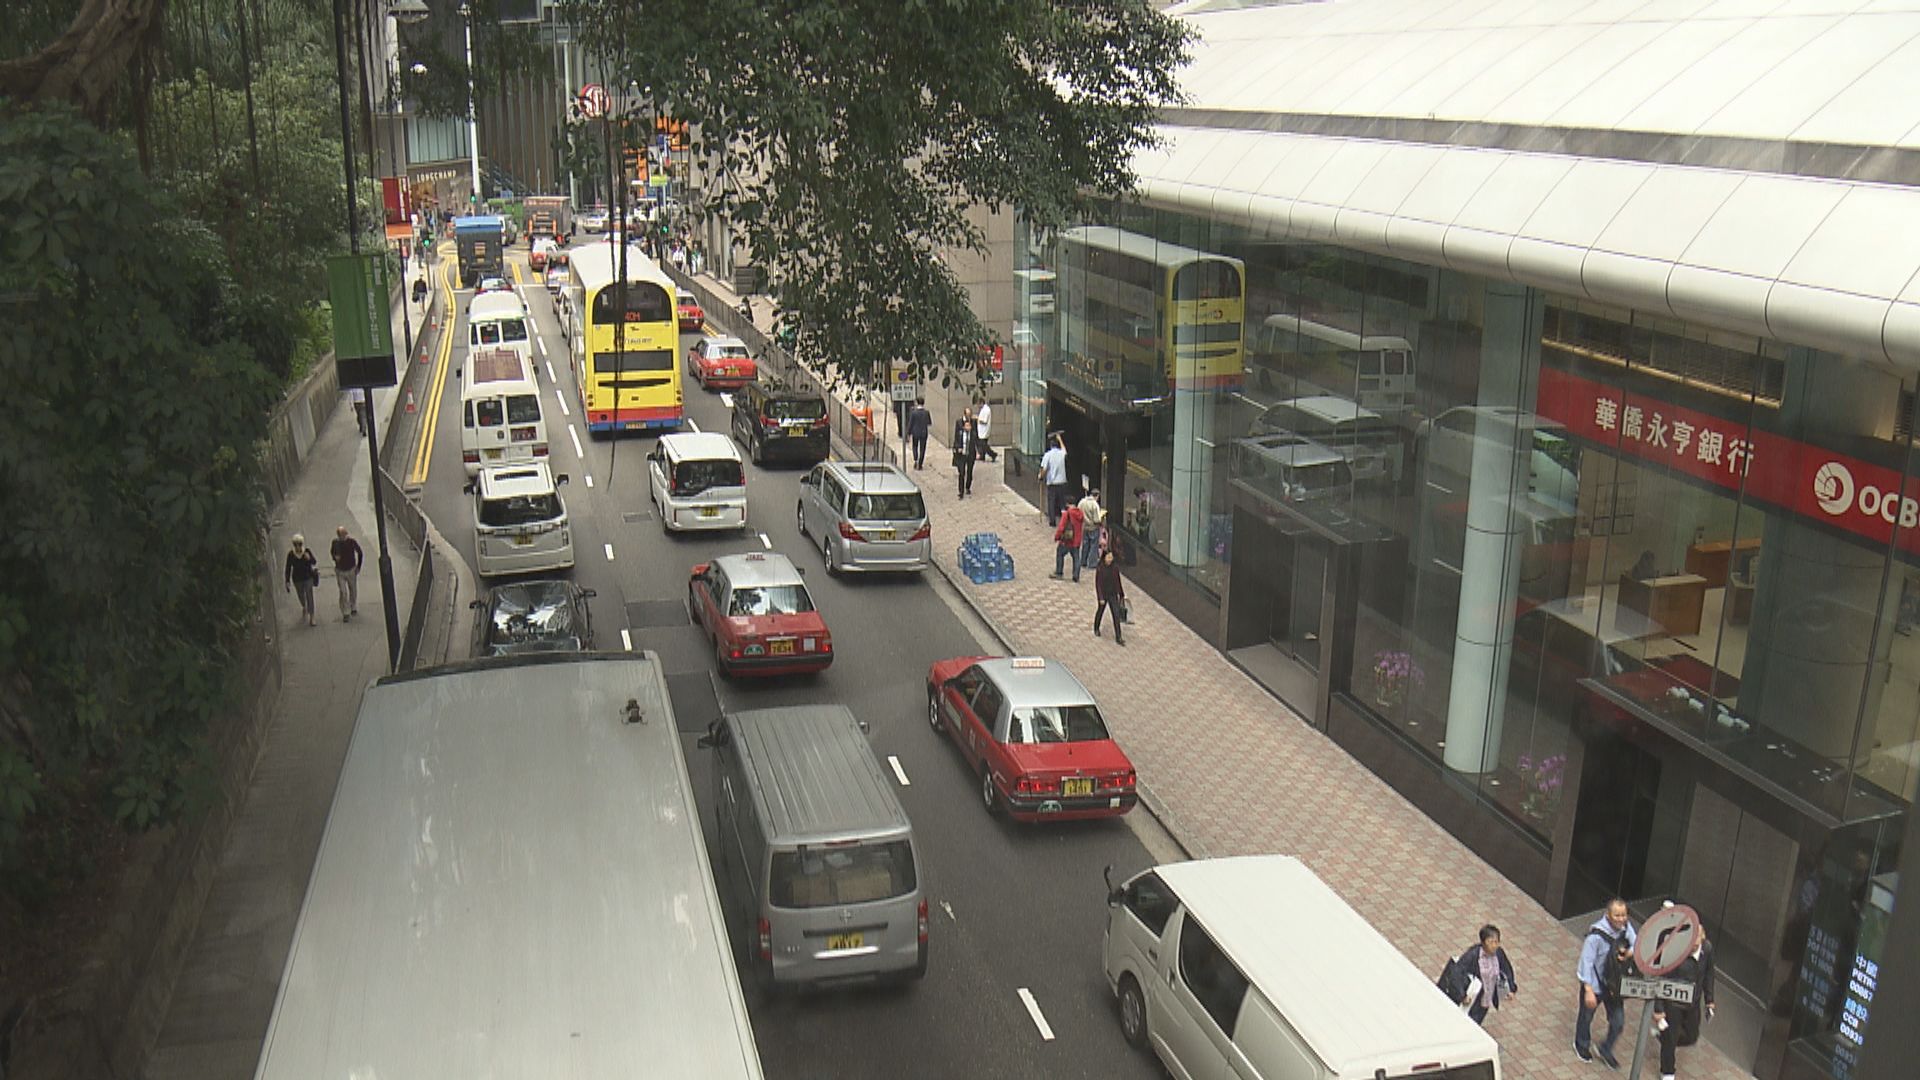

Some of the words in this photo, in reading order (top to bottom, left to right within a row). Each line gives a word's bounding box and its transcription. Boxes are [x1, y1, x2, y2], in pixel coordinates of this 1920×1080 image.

[416, 169, 457, 183] LONGCHAMP
[1595, 397, 1755, 478] 華僑永亨銀行
[1858, 486, 1920, 528] OCB
[1663, 983, 1689, 1001] 5m
